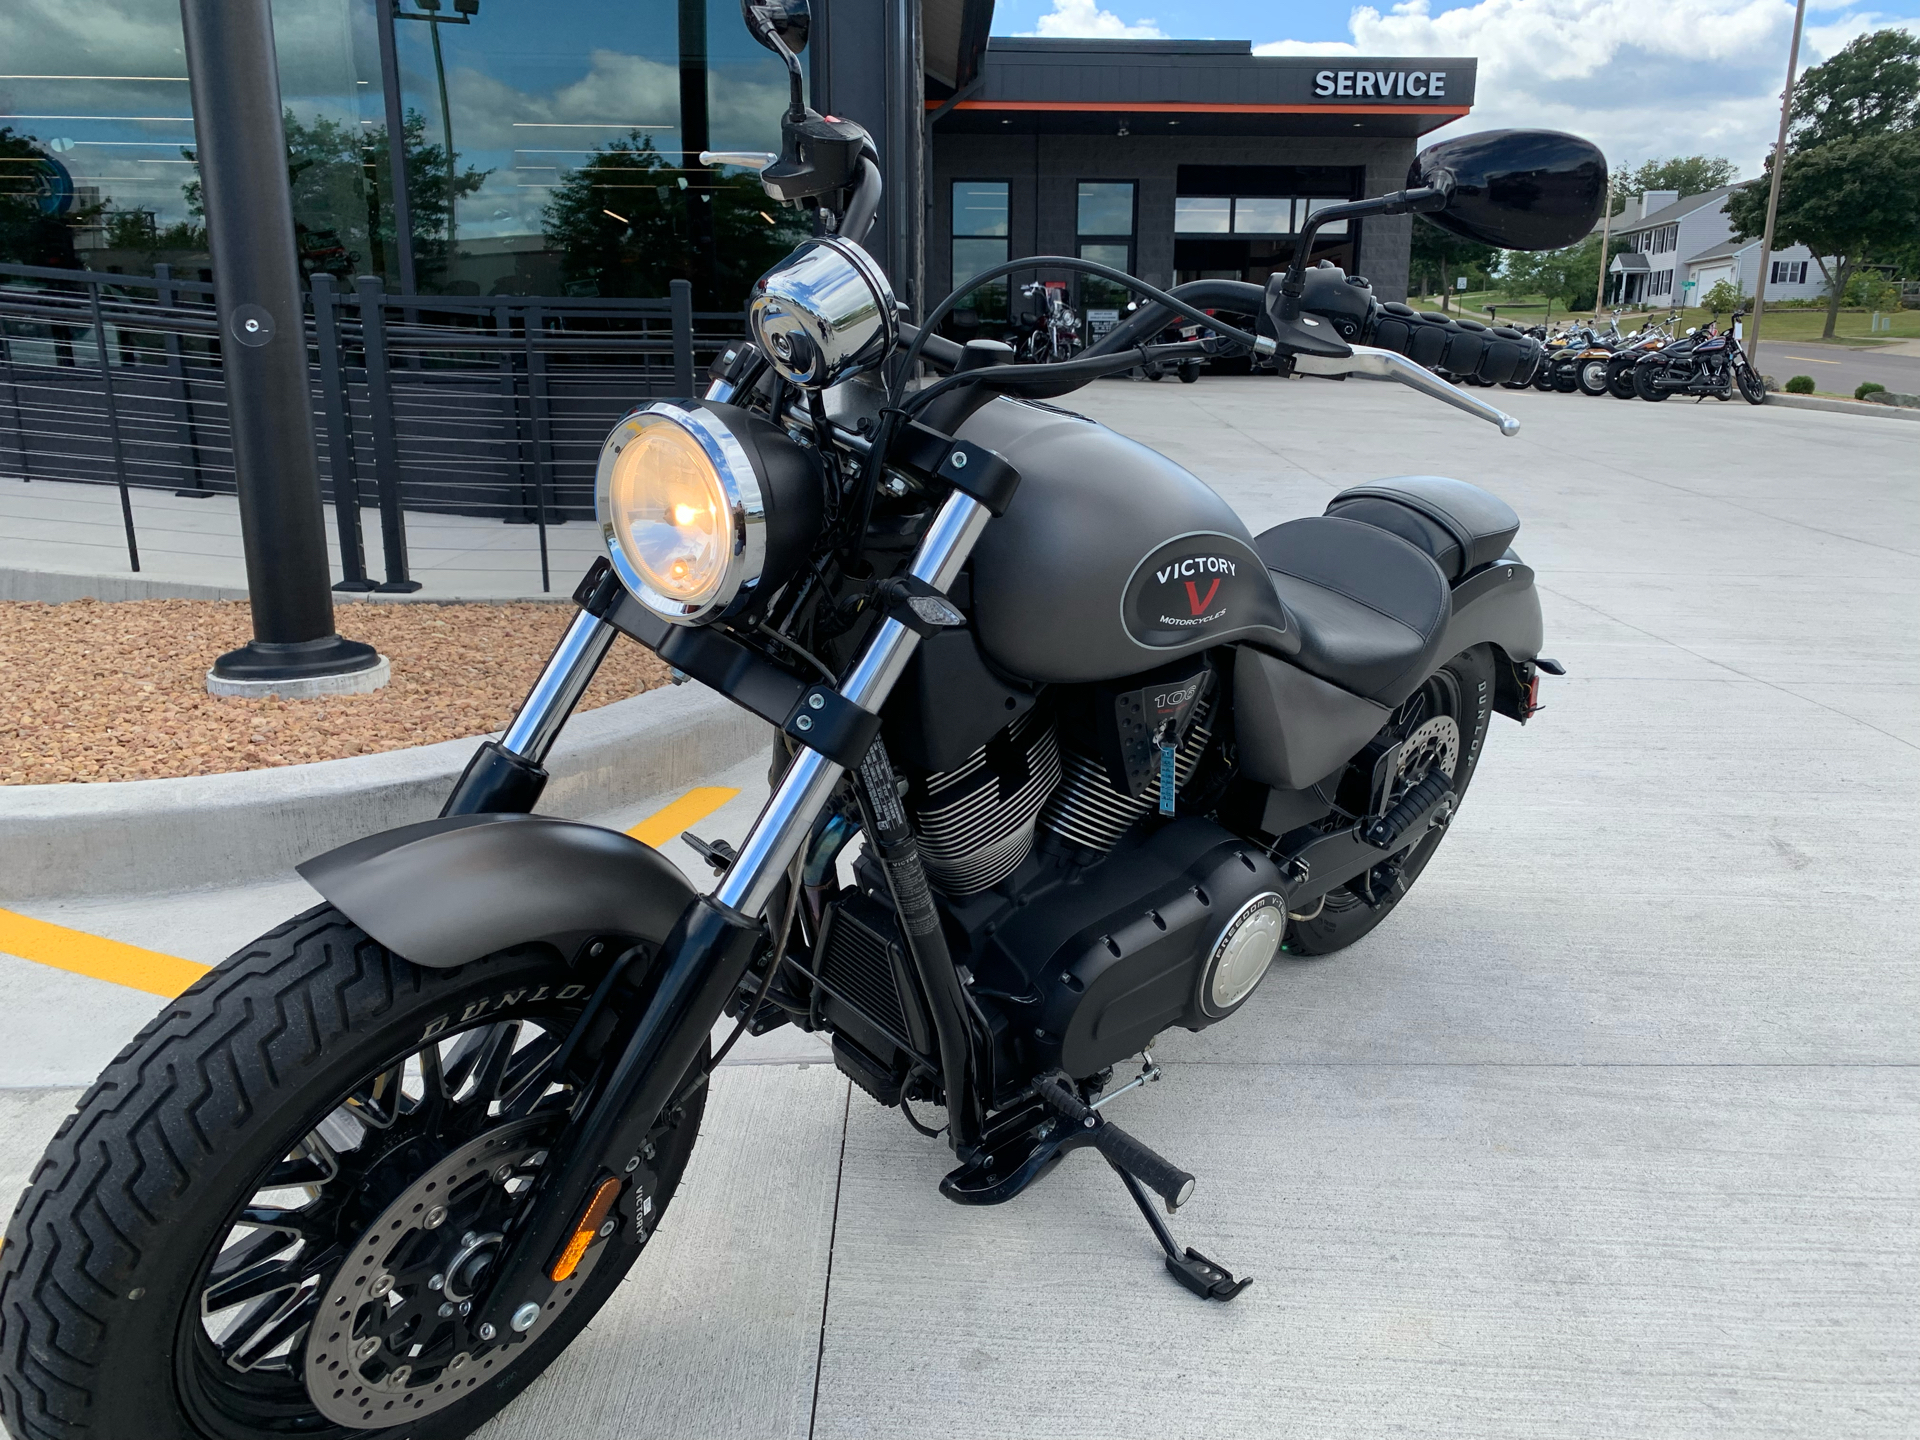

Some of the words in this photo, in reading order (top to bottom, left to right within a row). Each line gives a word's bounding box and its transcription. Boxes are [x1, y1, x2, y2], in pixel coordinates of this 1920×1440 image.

[1314, 70, 1447, 97] SERVICE
[1156, 556, 1236, 584] VICTORY
[1184, 578, 1221, 616] V
[1159, 608, 1227, 626] MOTORCYCLES
[1154, 685, 1197, 708] 106
[1467, 681, 1487, 767] DUNLOP
[1215, 899, 1265, 959] FREEDOM
[418, 984, 592, 1043] DUNLO
[635, 1184, 645, 1235] VICTORY
